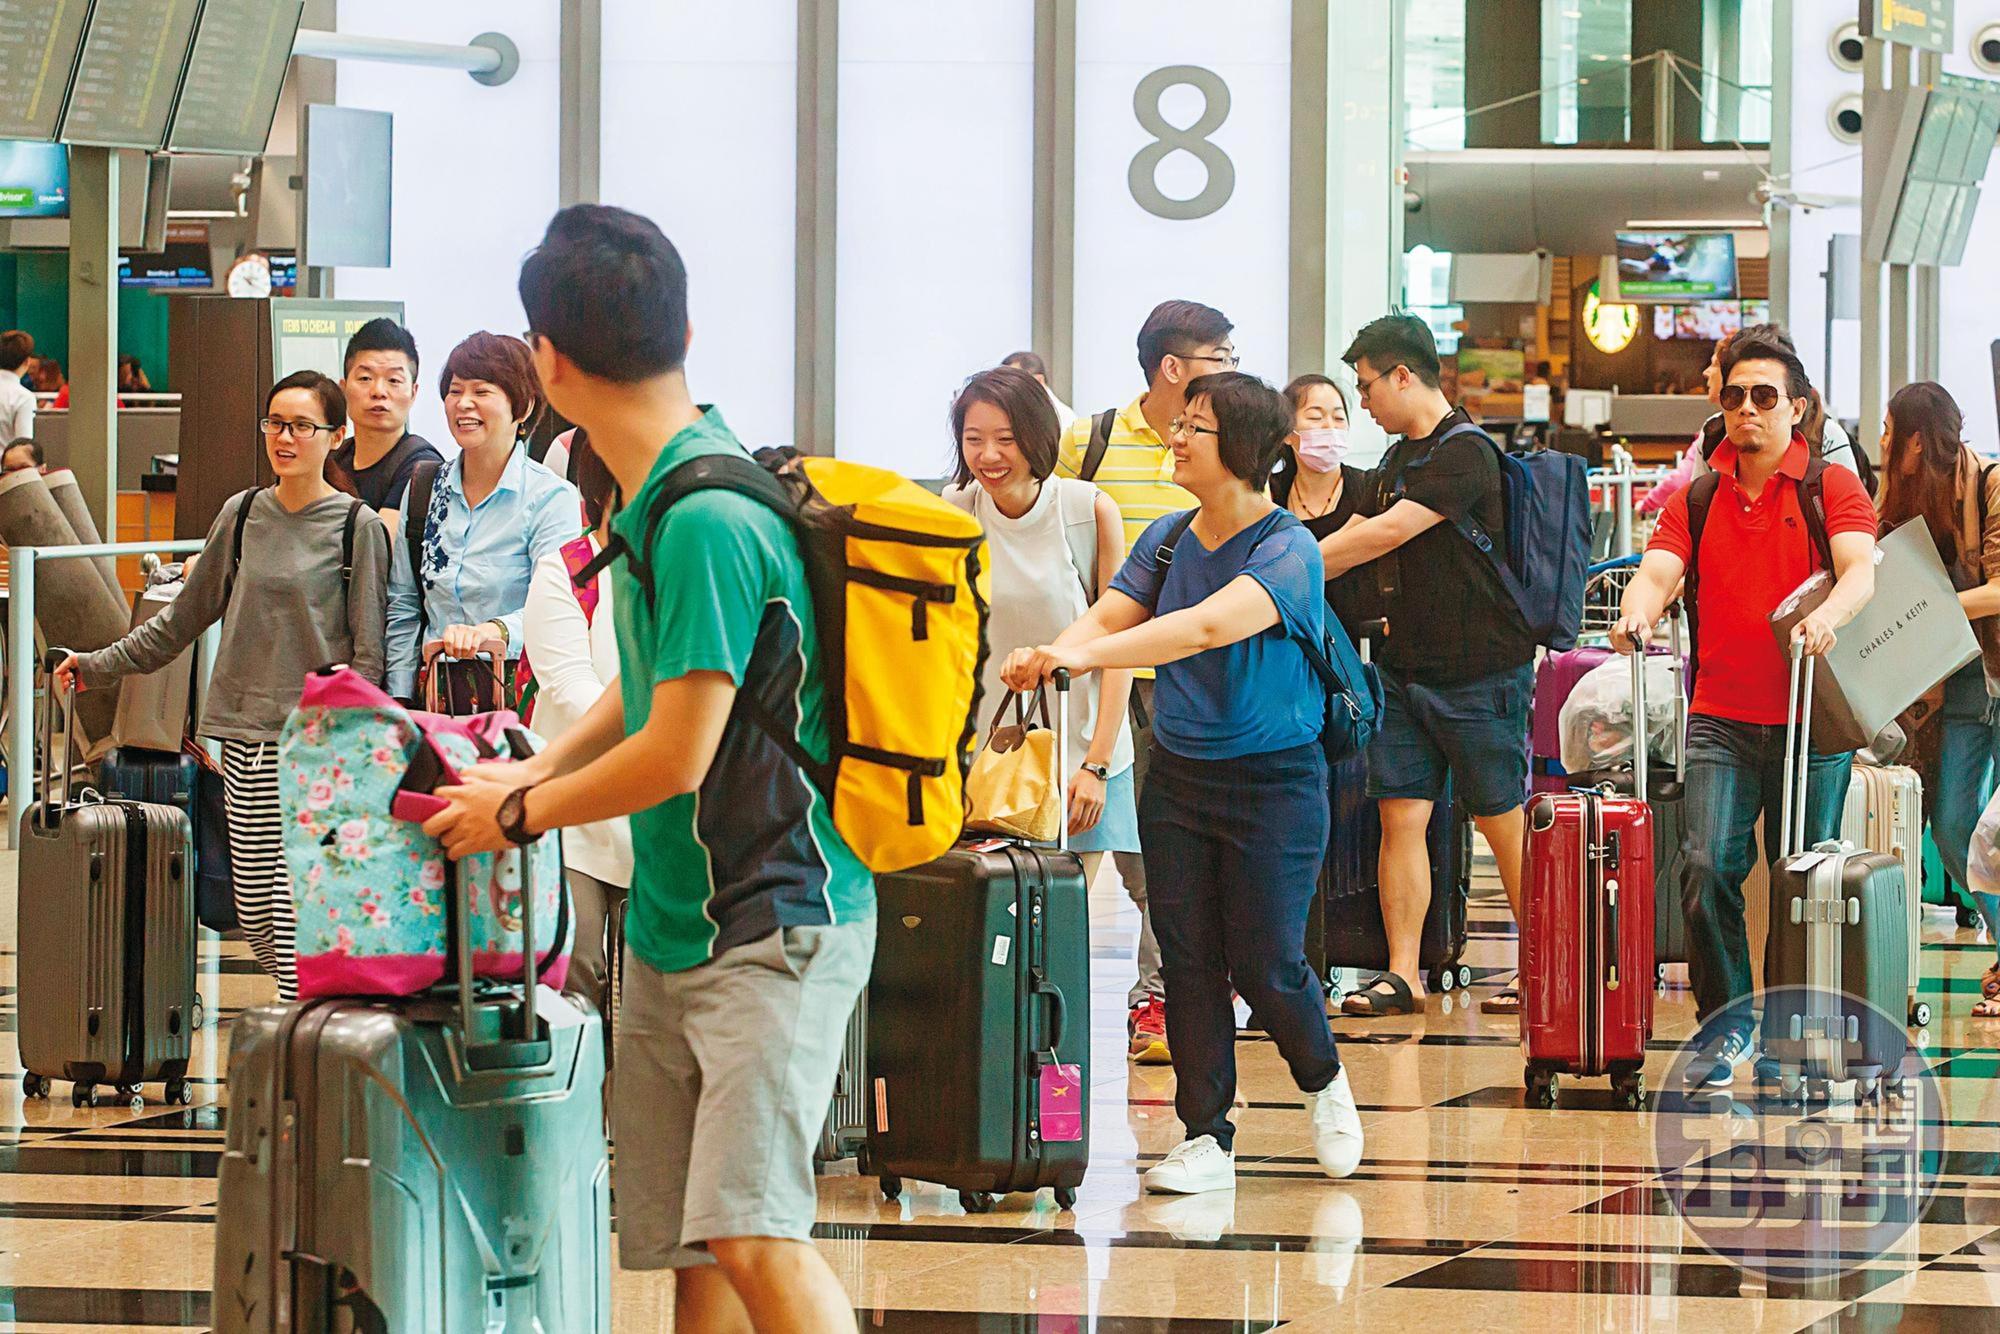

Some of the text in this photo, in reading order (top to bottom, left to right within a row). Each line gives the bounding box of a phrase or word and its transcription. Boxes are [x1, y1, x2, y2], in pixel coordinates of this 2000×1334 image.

[1128, 65, 1235, 220] 8
[283, 319, 301, 333] ITEMS
[301, 320, 309, 334] TO
[1859, 599, 1929, 659] CHARLES & KEITH
